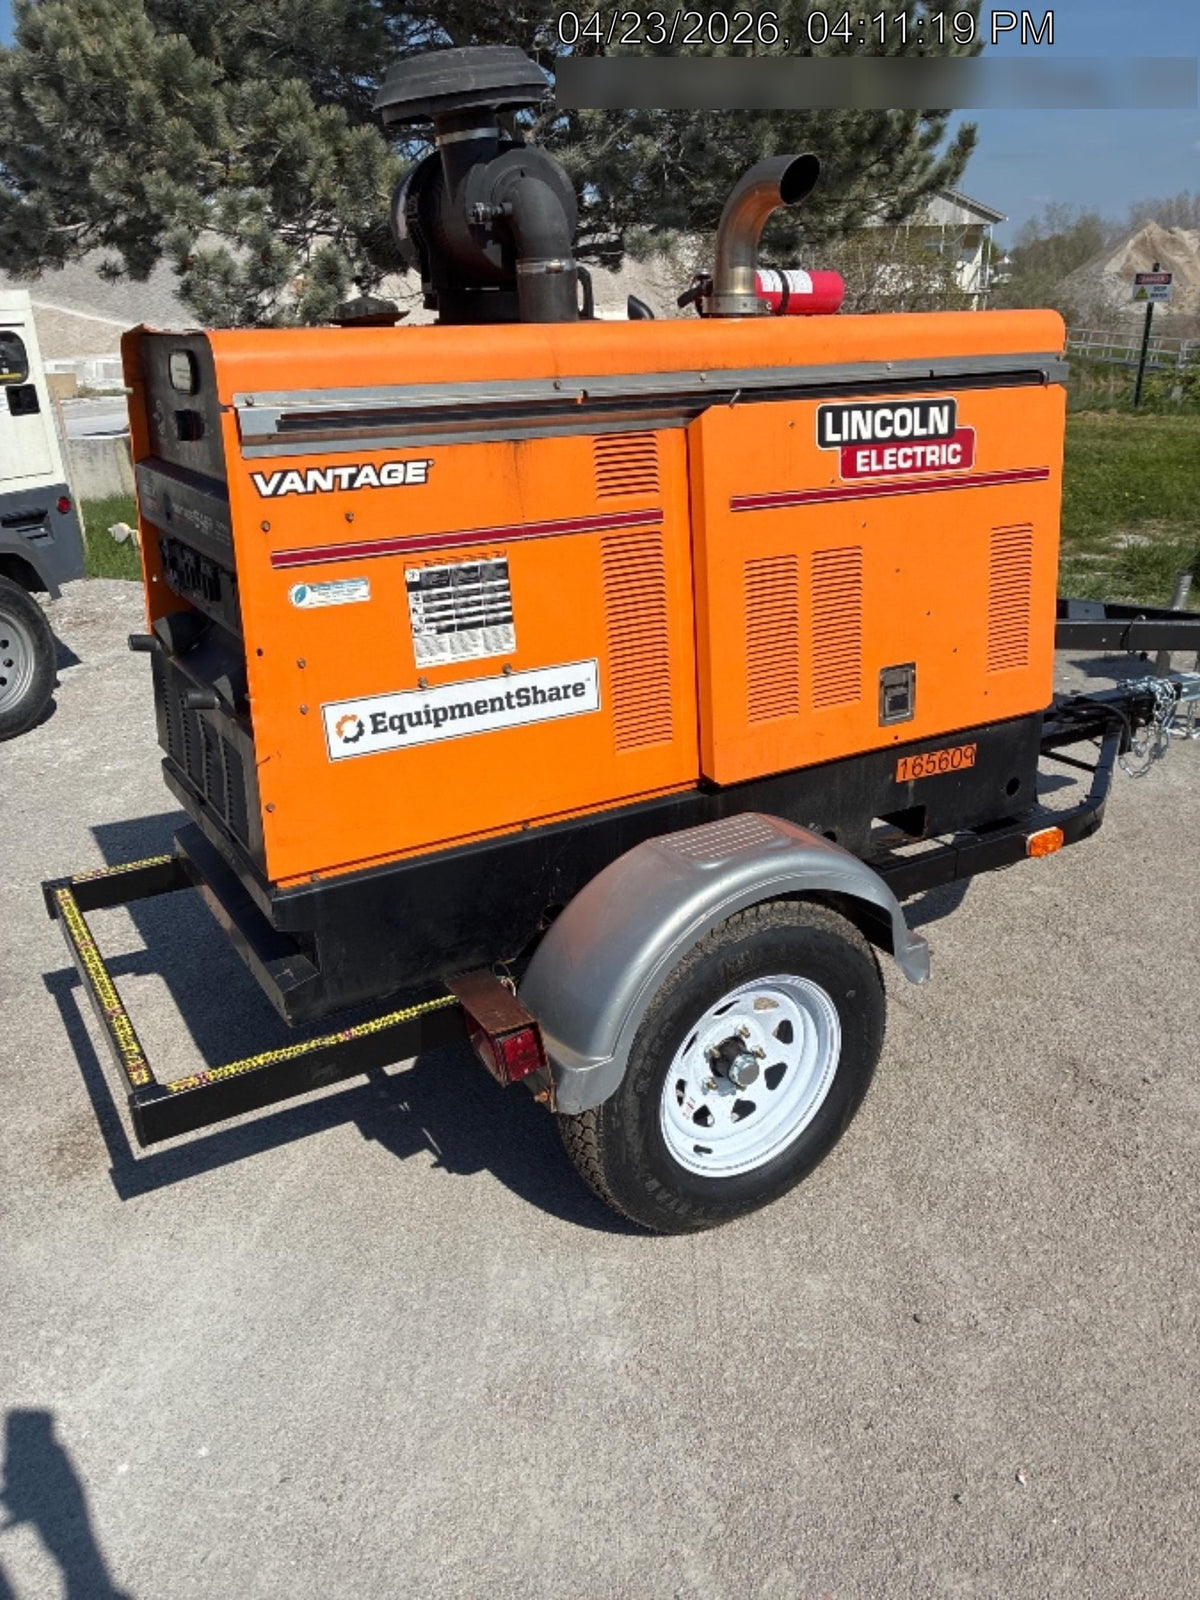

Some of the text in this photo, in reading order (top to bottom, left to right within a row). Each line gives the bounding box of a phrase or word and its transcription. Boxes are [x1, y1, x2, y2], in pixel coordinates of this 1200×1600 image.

[824, 405, 949, 442] LINCOLN
[856, 443, 962, 473] ELECTRIC
[250, 460, 430, 498] VANTAGE
[369, 680, 587, 735] EquipmentShare
[900, 745, 975, 779] 165609
